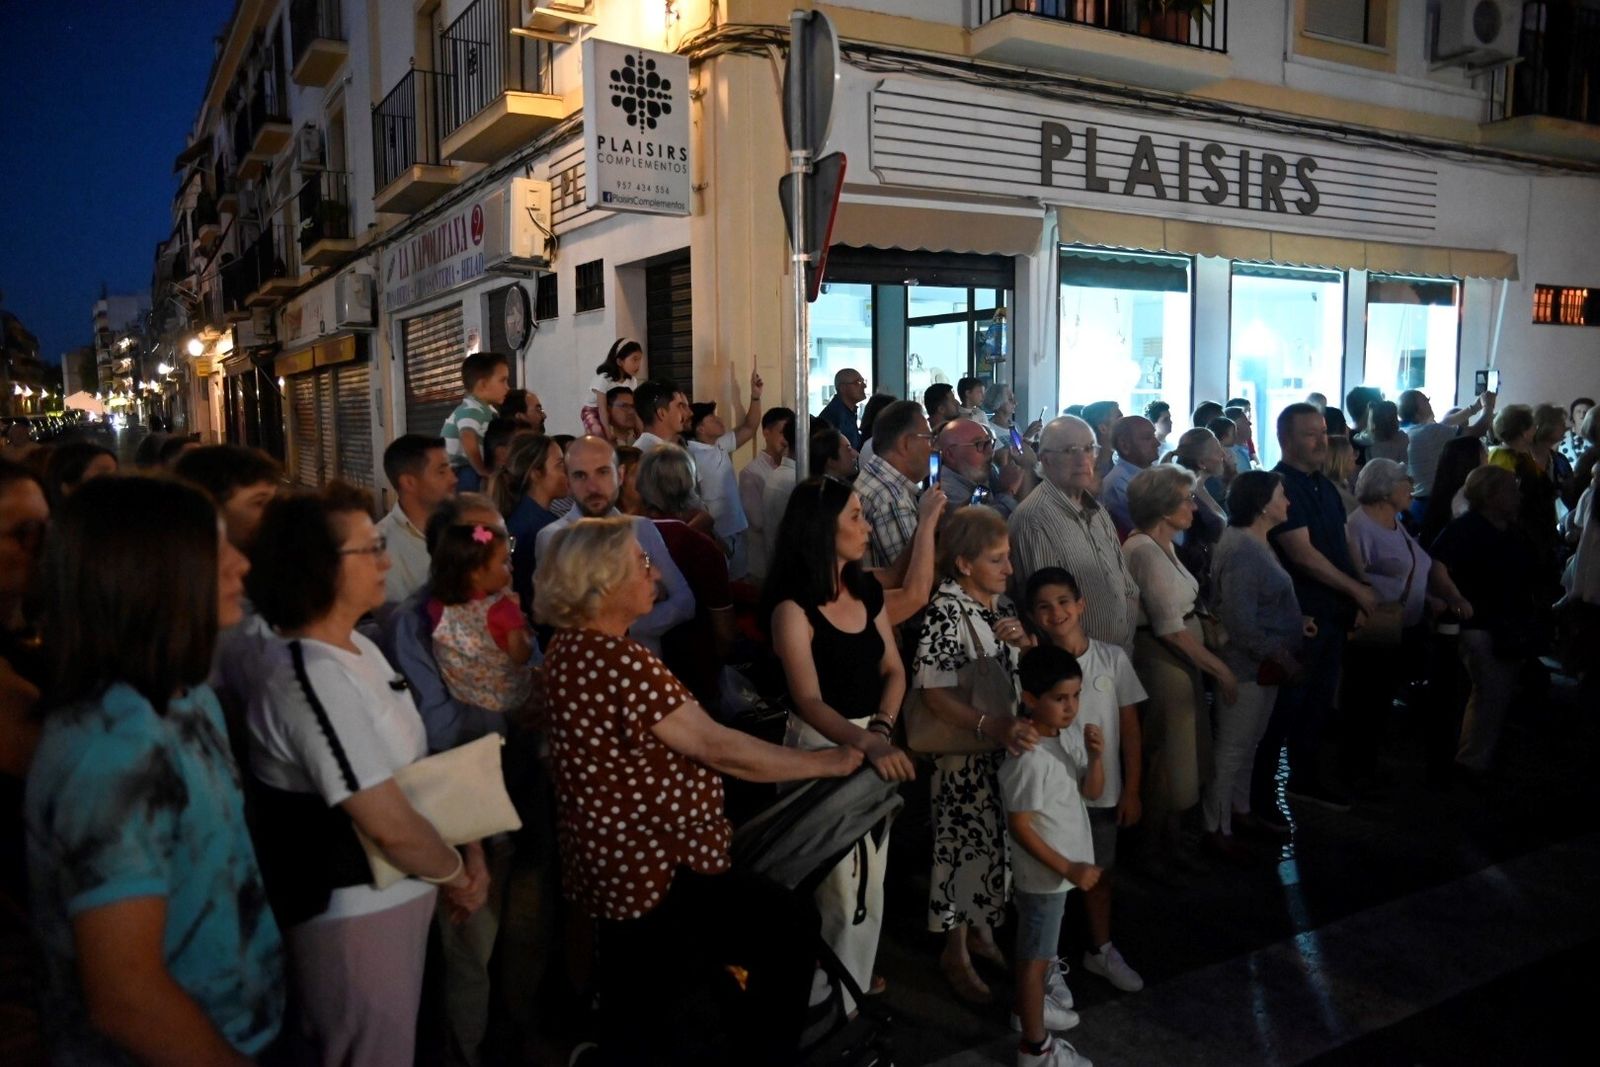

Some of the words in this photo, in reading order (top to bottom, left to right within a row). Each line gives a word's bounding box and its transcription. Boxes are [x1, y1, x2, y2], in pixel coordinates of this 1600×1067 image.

[597, 135, 687, 161] PLAISIRS
[597, 153, 687, 174] COMPLEMENTOS
[1041, 121, 1320, 216] PLAISIRS
[616, 181, 631, 190] 957
[399, 245, 409, 280] LA
